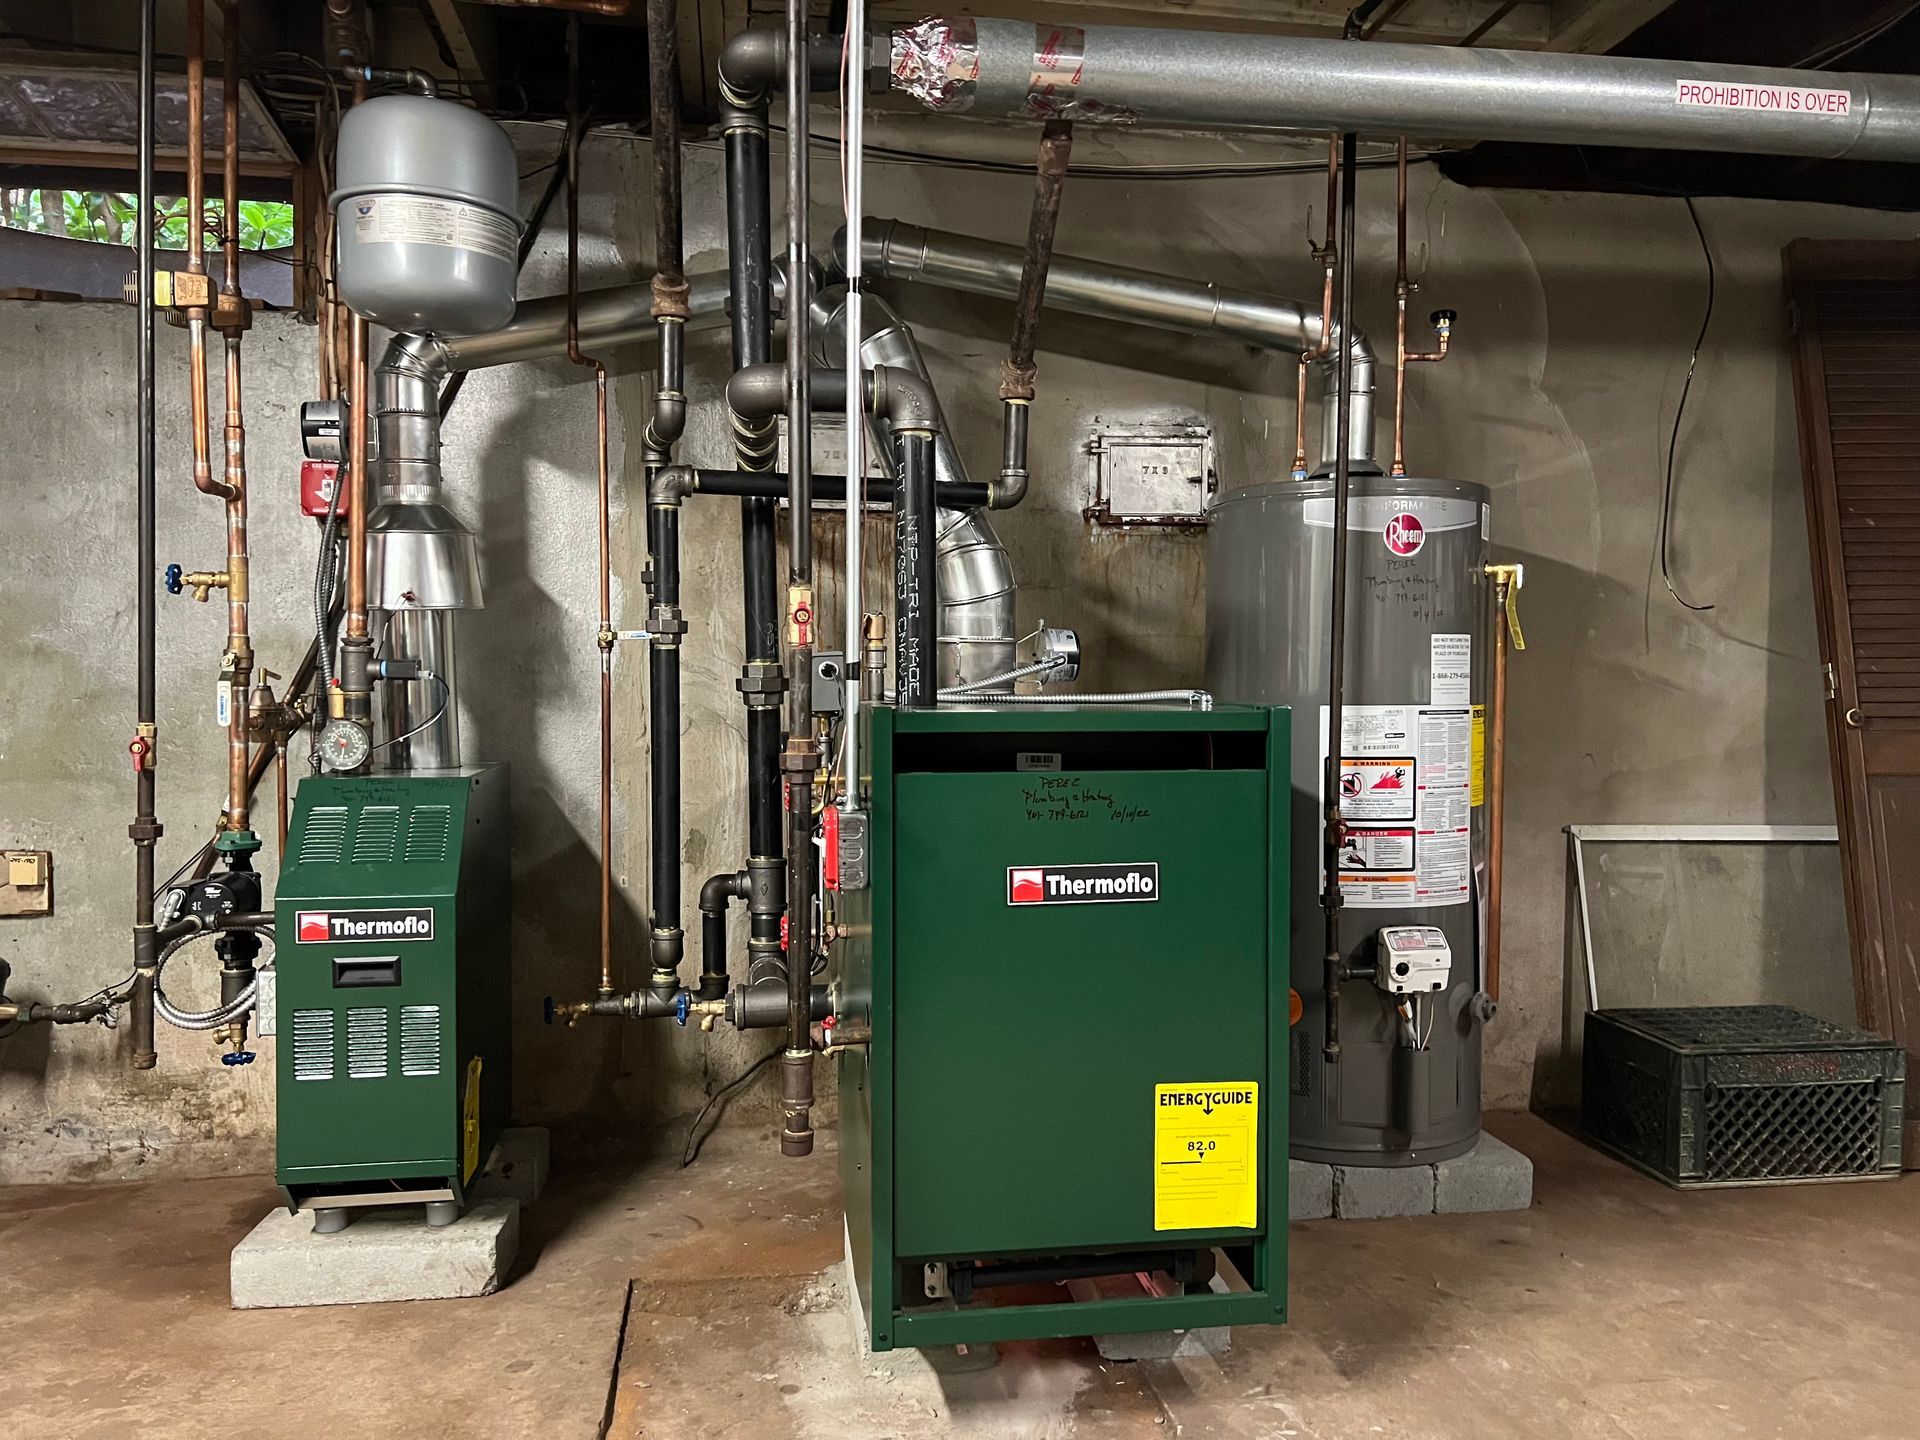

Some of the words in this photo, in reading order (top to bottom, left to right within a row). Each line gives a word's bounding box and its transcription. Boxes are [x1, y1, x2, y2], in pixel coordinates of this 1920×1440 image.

[1679, 85, 1782, 109] PROHIBITION
[1785, 92, 1800, 109] IS
[1804, 93, 1847, 112] OVER
[1389, 512, 1422, 549] Rheem
[909, 637, 920, 697] MADE
[1046, 872, 1153, 895] Thermoflo
[330, 916, 430, 936] Thermoflo
[1160, 1091, 1253, 1108] ENERGYGUIDE
[1187, 1140, 1216, 1151] 82.0
